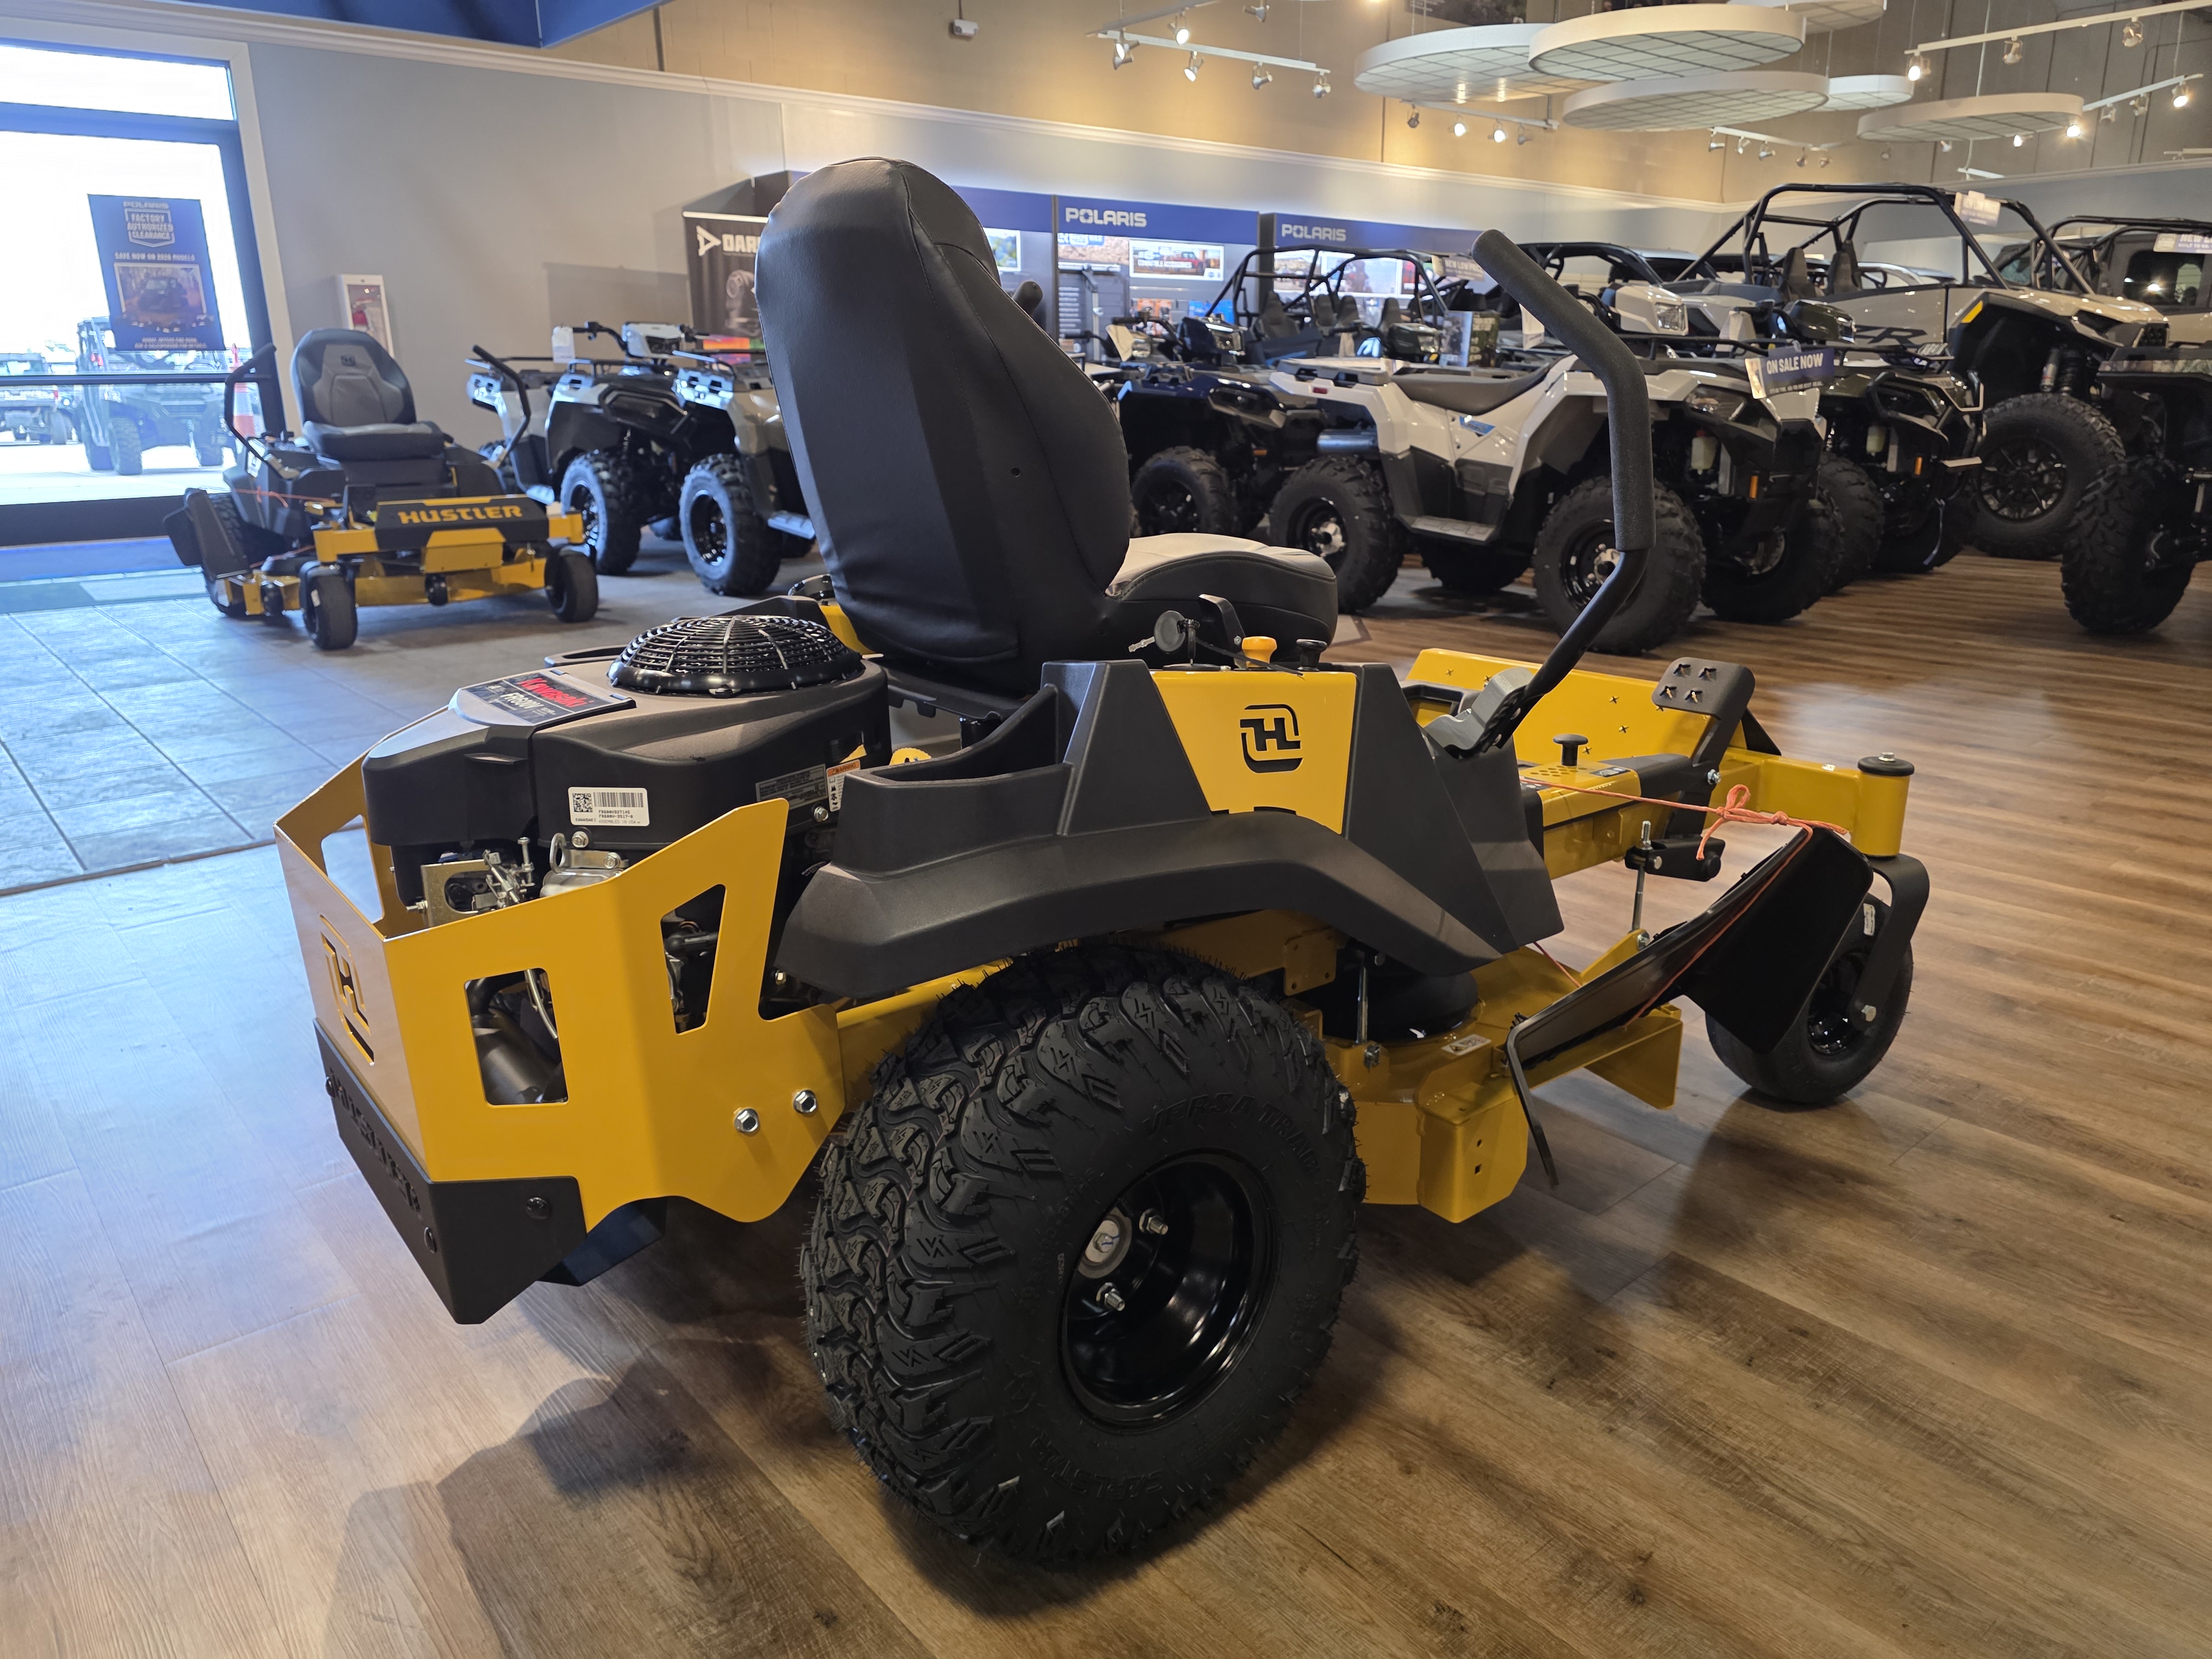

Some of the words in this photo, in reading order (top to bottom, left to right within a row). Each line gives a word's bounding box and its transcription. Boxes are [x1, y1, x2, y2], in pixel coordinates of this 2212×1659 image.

[123, 201, 170, 209] POLARIS
[131, 213, 165, 223] FACTORY
[1065, 207, 1147, 227] POLARIS
[127, 222, 174, 232] AUTHORIZED
[132, 231, 171, 240] CLEARANCE
[1281, 224, 1347, 241] POLARIS
[722, 233, 761, 253] DAR
[2180, 234, 2202, 243] NEW
[1766, 360, 1778, 374] ON
[1778, 356, 1799, 373] SALE
[1800, 352, 1824, 369] NOW
[397, 505, 523, 524] HUSTLER
[500, 692, 544, 709] FR600V
[515, 677, 596, 708] Kawasaki
[836, 762, 856, 773] WARNING
[1141, 1092, 1256, 1140] VERSA
